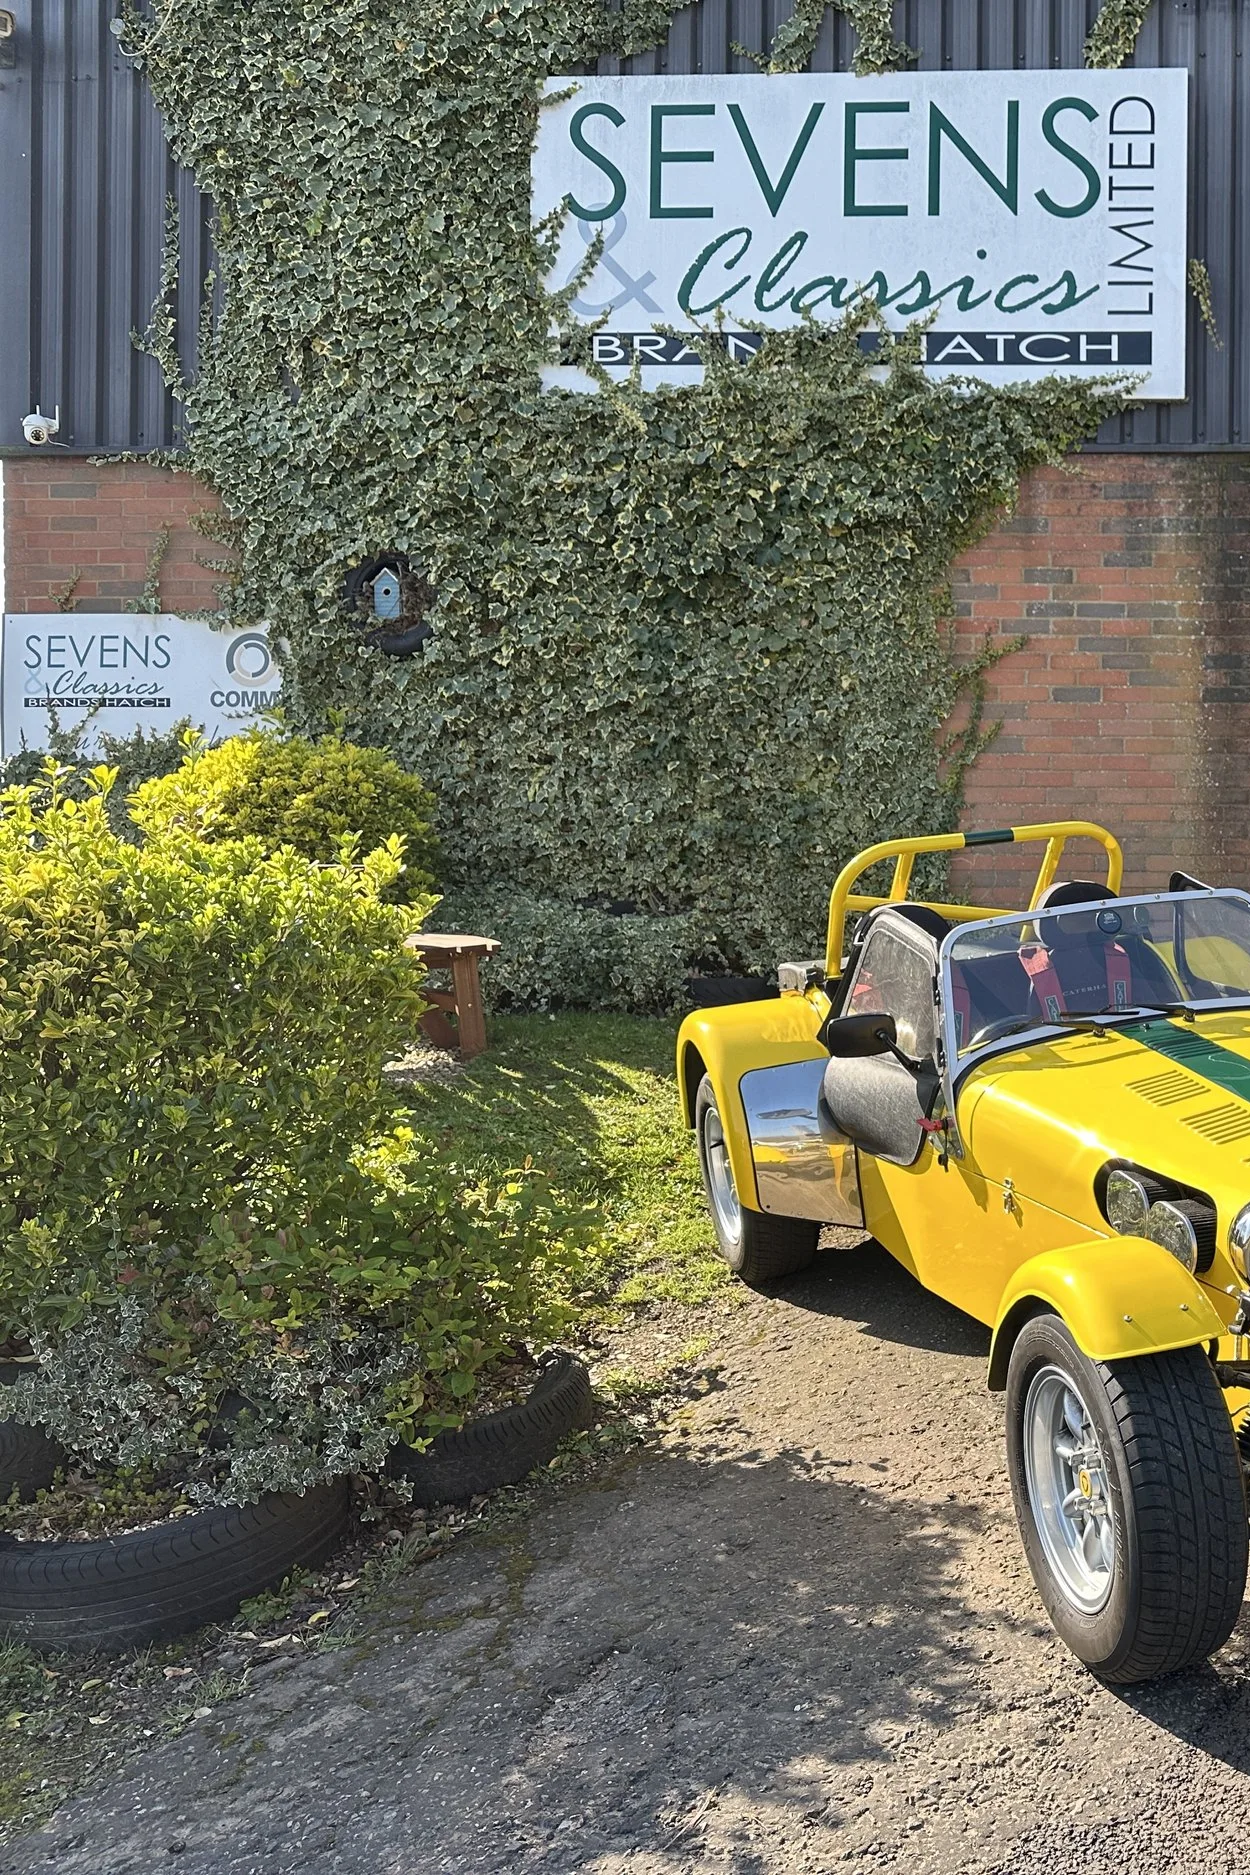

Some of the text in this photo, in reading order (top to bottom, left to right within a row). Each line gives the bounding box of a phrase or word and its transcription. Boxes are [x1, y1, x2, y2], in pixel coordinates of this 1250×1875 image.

[562, 96, 1101, 221] SEVENS
[1108, 95, 1156, 316] LIMITED
[564, 202, 1101, 317] & Classics
[592, 334, 762, 363] BRAN
[23, 634, 171, 669] SEVENS
[53, 669, 165, 696] Classics
[28, 698, 168, 707] BRANDS HATCH
[1062, 984, 1107, 997] CATERHA
